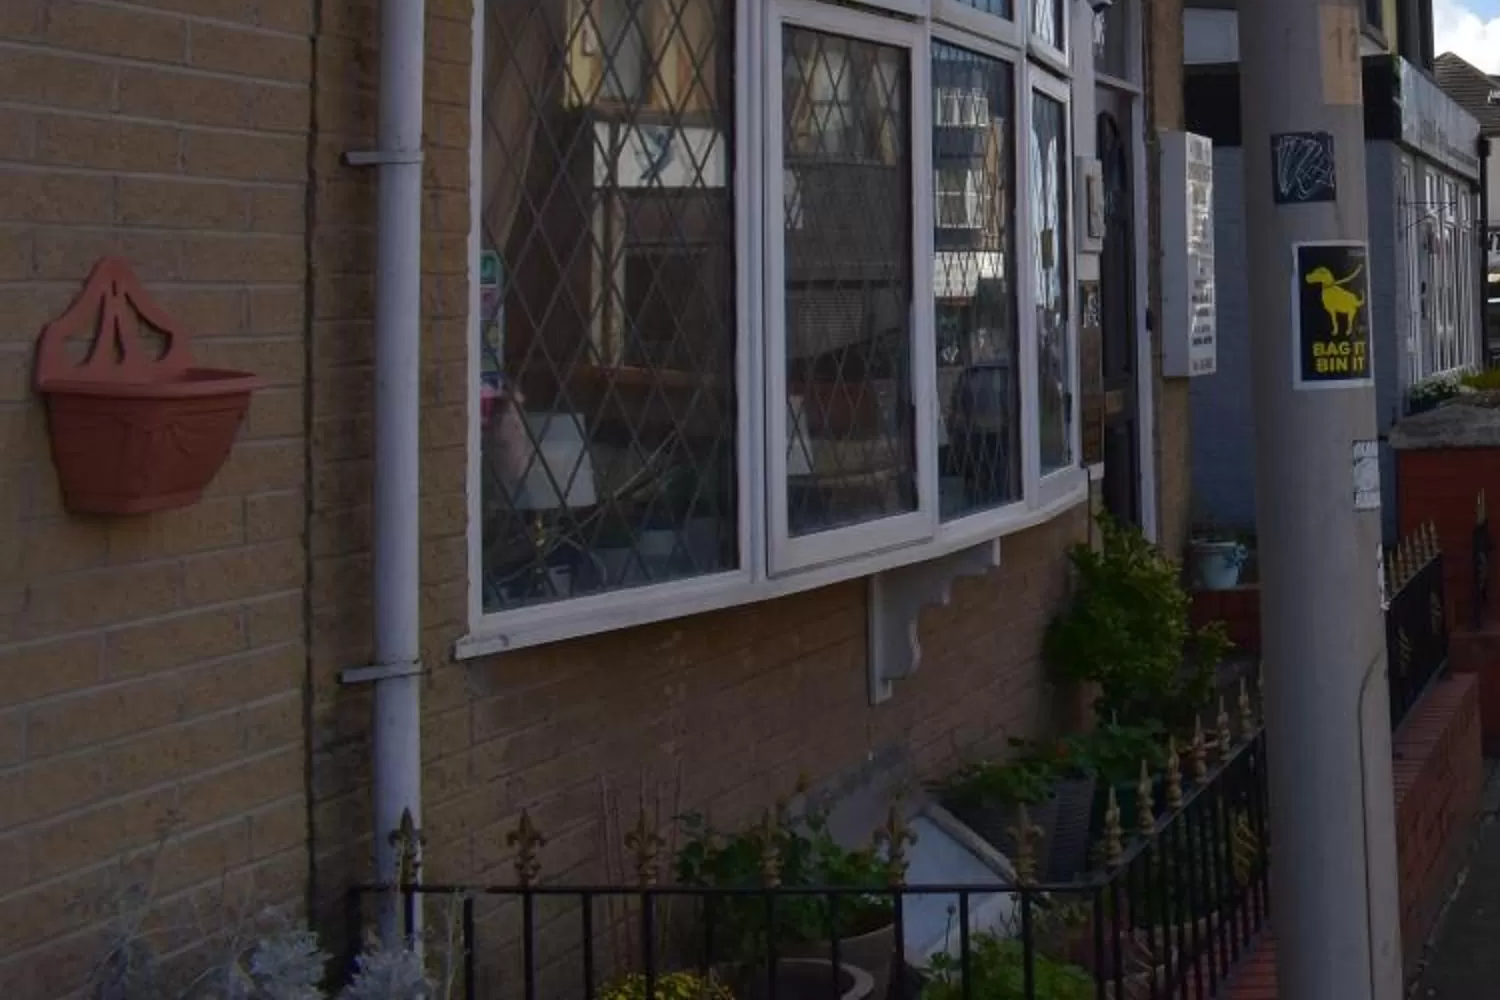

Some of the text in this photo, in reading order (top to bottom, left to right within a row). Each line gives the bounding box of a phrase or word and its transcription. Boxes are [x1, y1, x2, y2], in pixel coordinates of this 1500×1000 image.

[1312, 341, 1367, 357] BAG IT
[1315, 357, 1365, 373] BIN IT
